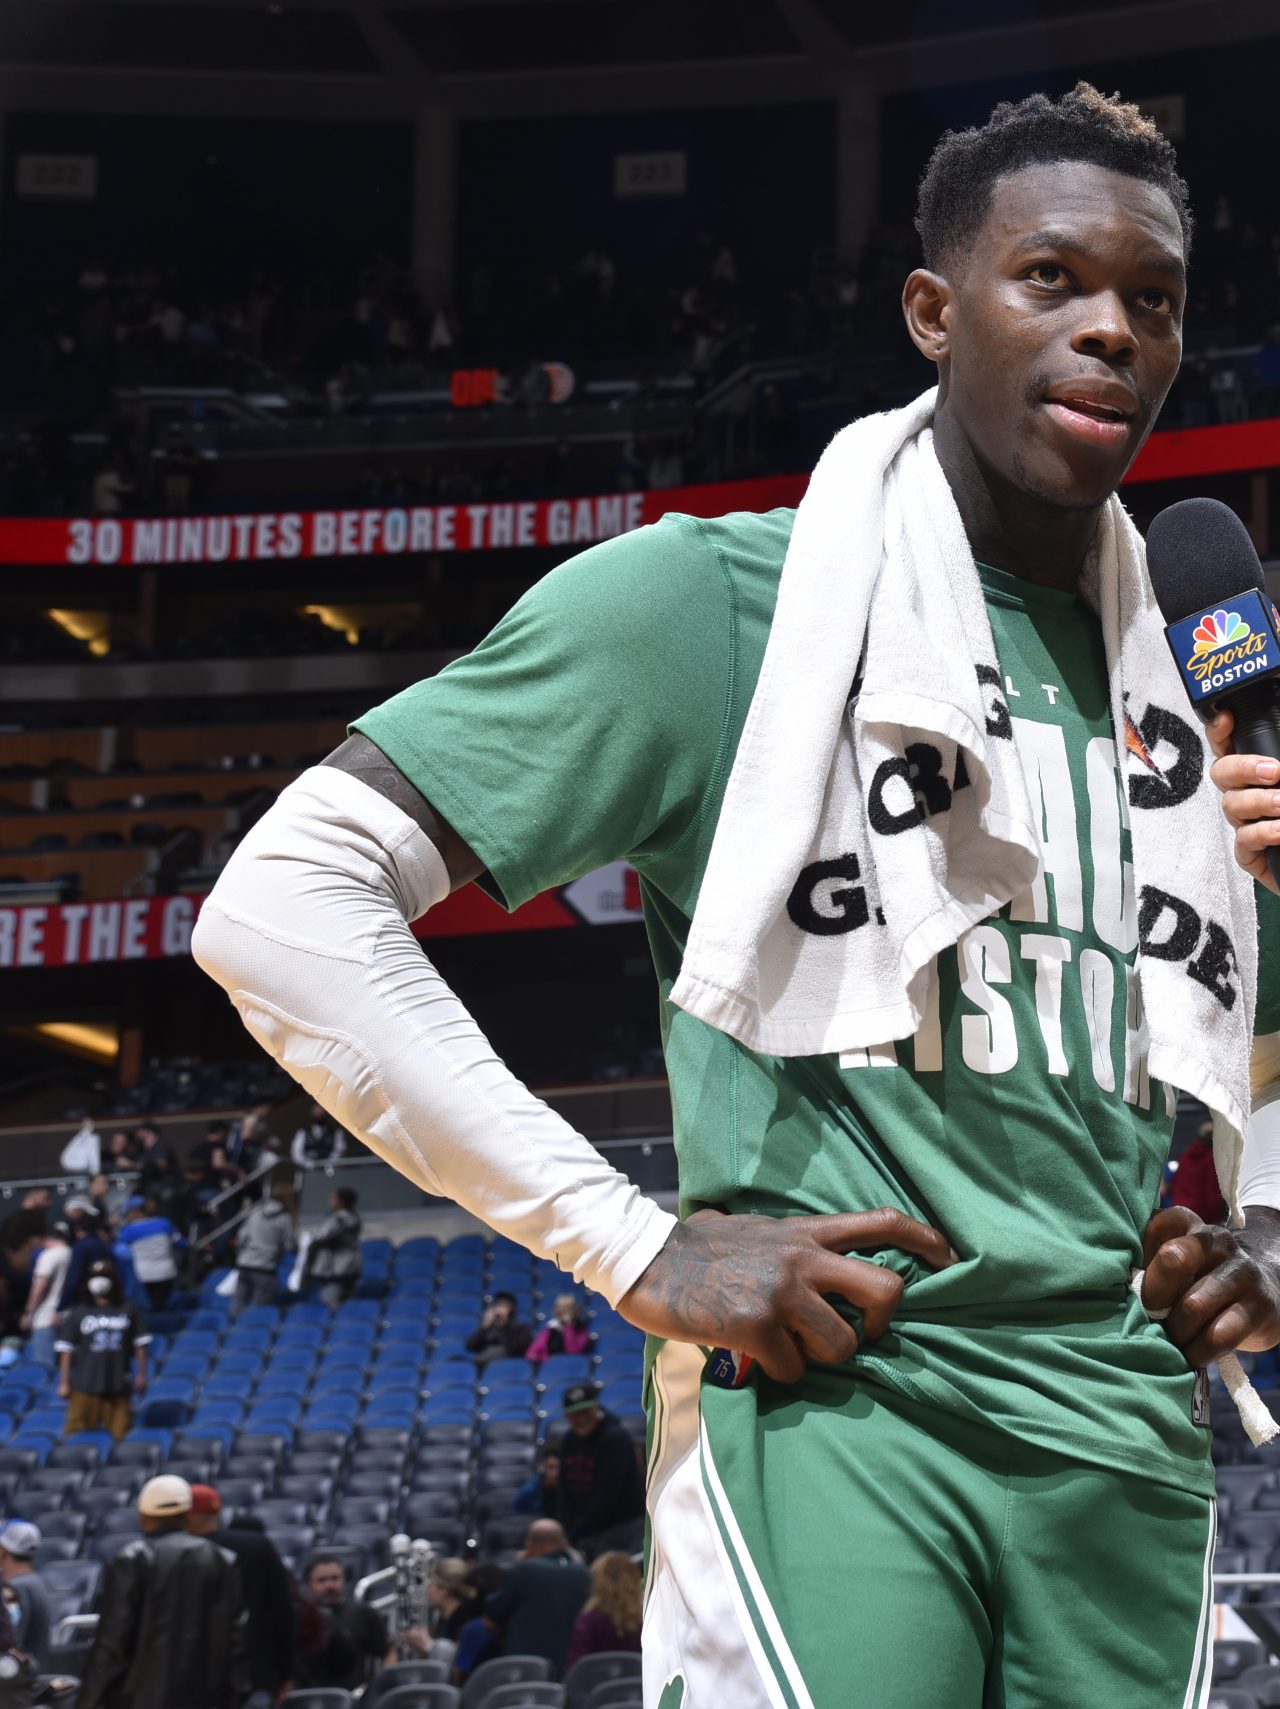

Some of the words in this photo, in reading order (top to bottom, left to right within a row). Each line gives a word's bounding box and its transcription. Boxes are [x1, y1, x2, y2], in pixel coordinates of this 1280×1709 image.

[67, 518, 122, 565] 30
[132, 512, 302, 564] MINUTES
[312, 506, 456, 557] BEFORE
[466, 503, 537, 548] THE
[546, 493, 645, 543] GAME
[1186, 632, 1267, 681] Sports
[1201, 654, 1268, 693] BOSTON
[61, 900, 149, 963] THE
[715, 1358, 732, 1378] 75
